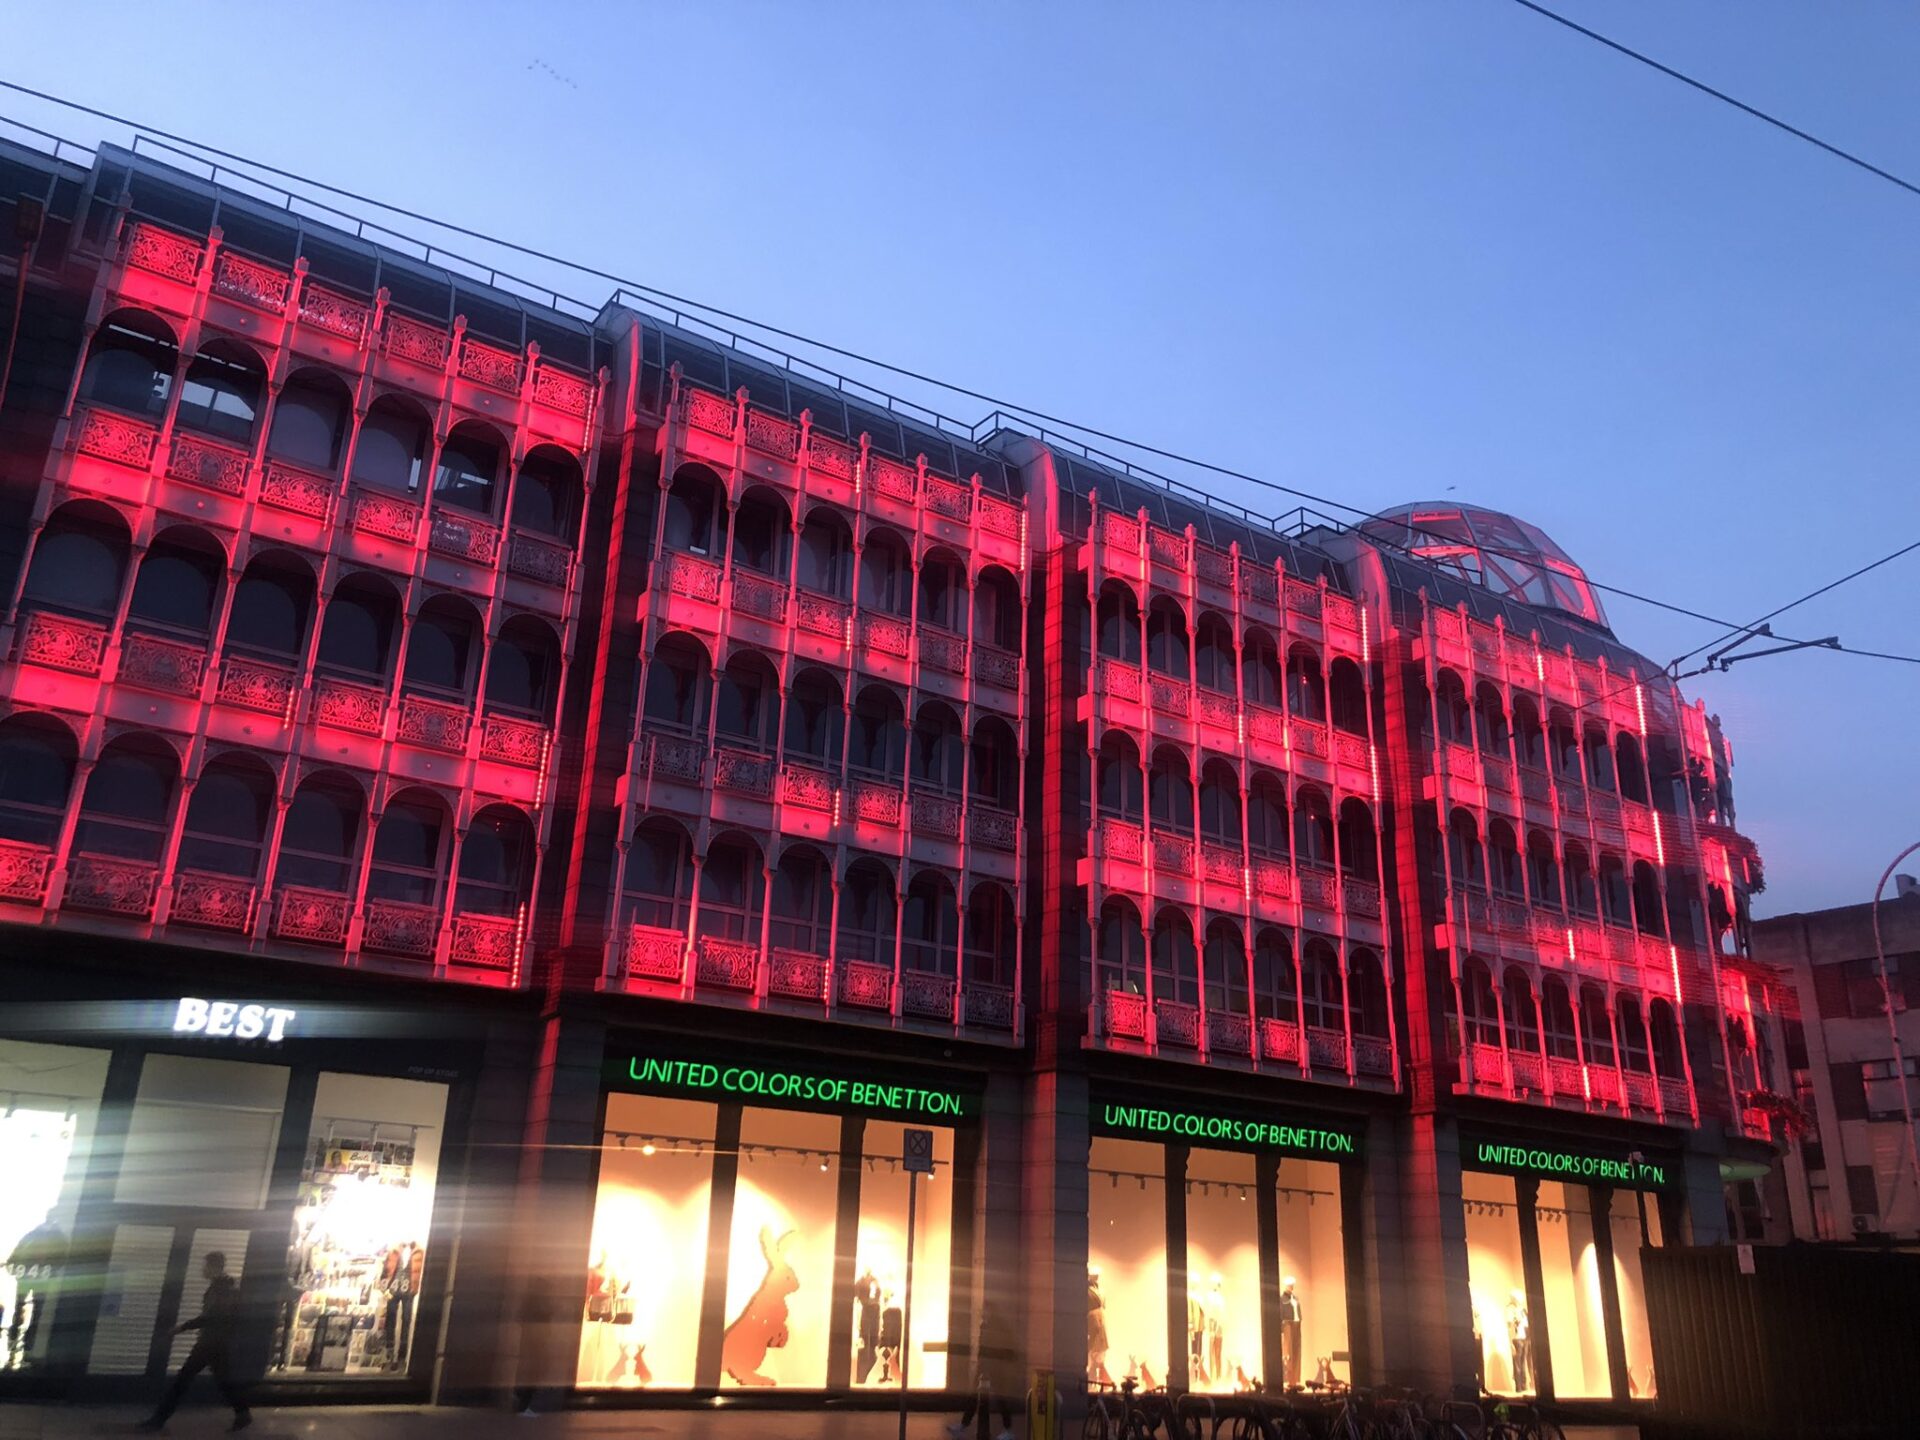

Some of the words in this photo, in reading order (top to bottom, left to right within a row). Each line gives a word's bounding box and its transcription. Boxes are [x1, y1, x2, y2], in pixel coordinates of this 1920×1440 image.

[174, 998, 295, 1042] BEST
[629, 1057, 718, 1088] UNITED
[722, 1068, 816, 1098] COLORS
[817, 1079, 848, 1101] OF
[1105, 1104, 1170, 1131] UNITED
[1173, 1113, 1242, 1140] COLORS
[1245, 1122, 1268, 1143] OF
[1478, 1144, 1527, 1167] UNITED
[1528, 1151, 1581, 1173] COLORS
[1582, 1157, 1600, 1176] OF
[7, 1263, 52, 1280] 1948
